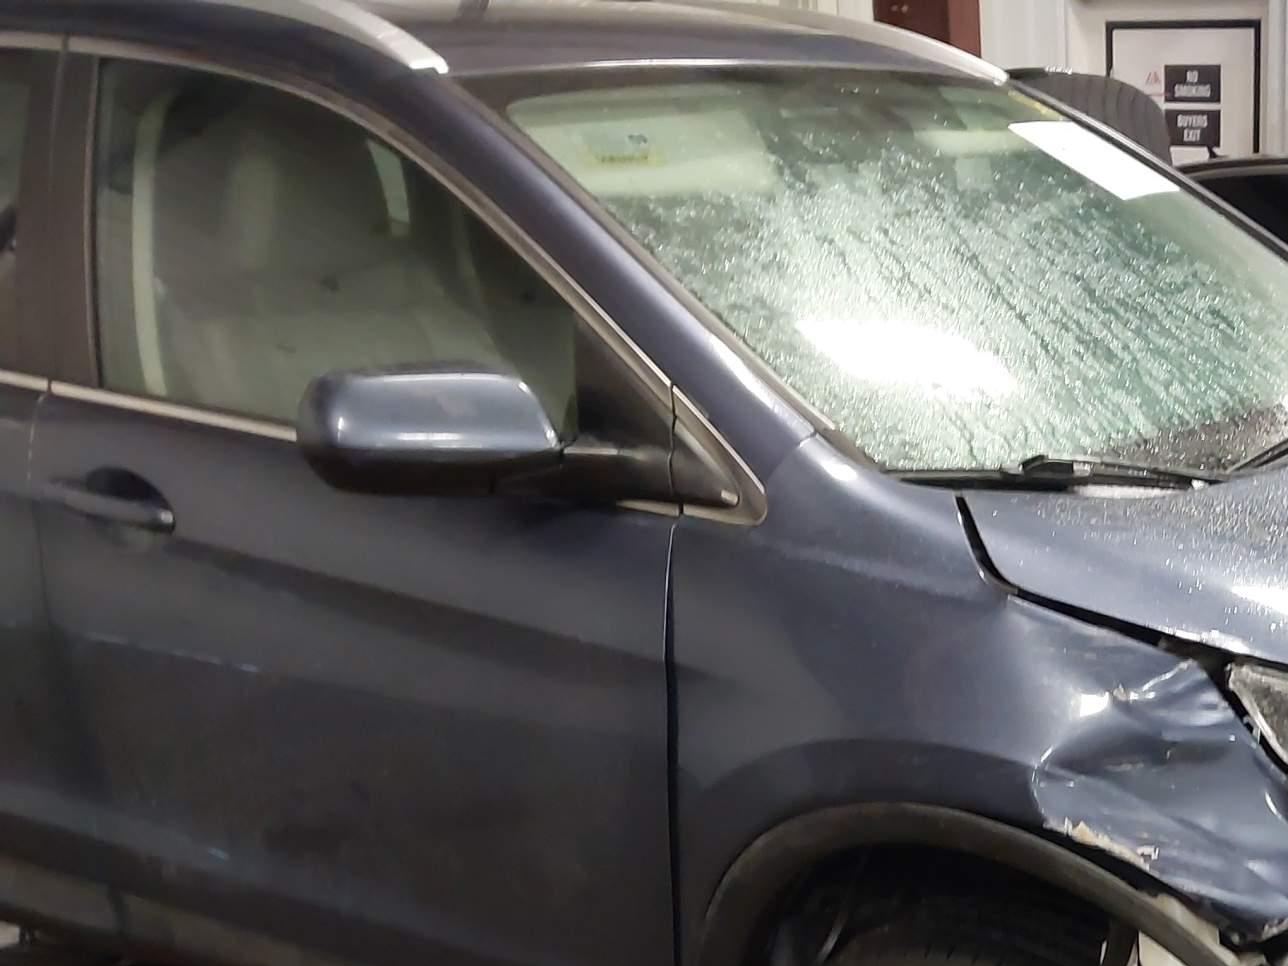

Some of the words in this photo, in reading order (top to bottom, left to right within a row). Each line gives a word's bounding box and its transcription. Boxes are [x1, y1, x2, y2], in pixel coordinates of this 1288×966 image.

[1186, 70, 1199, 82] NO
[1174, 83, 1211, 98] SMOKING
[1183, 128, 1200, 142] EXIT
